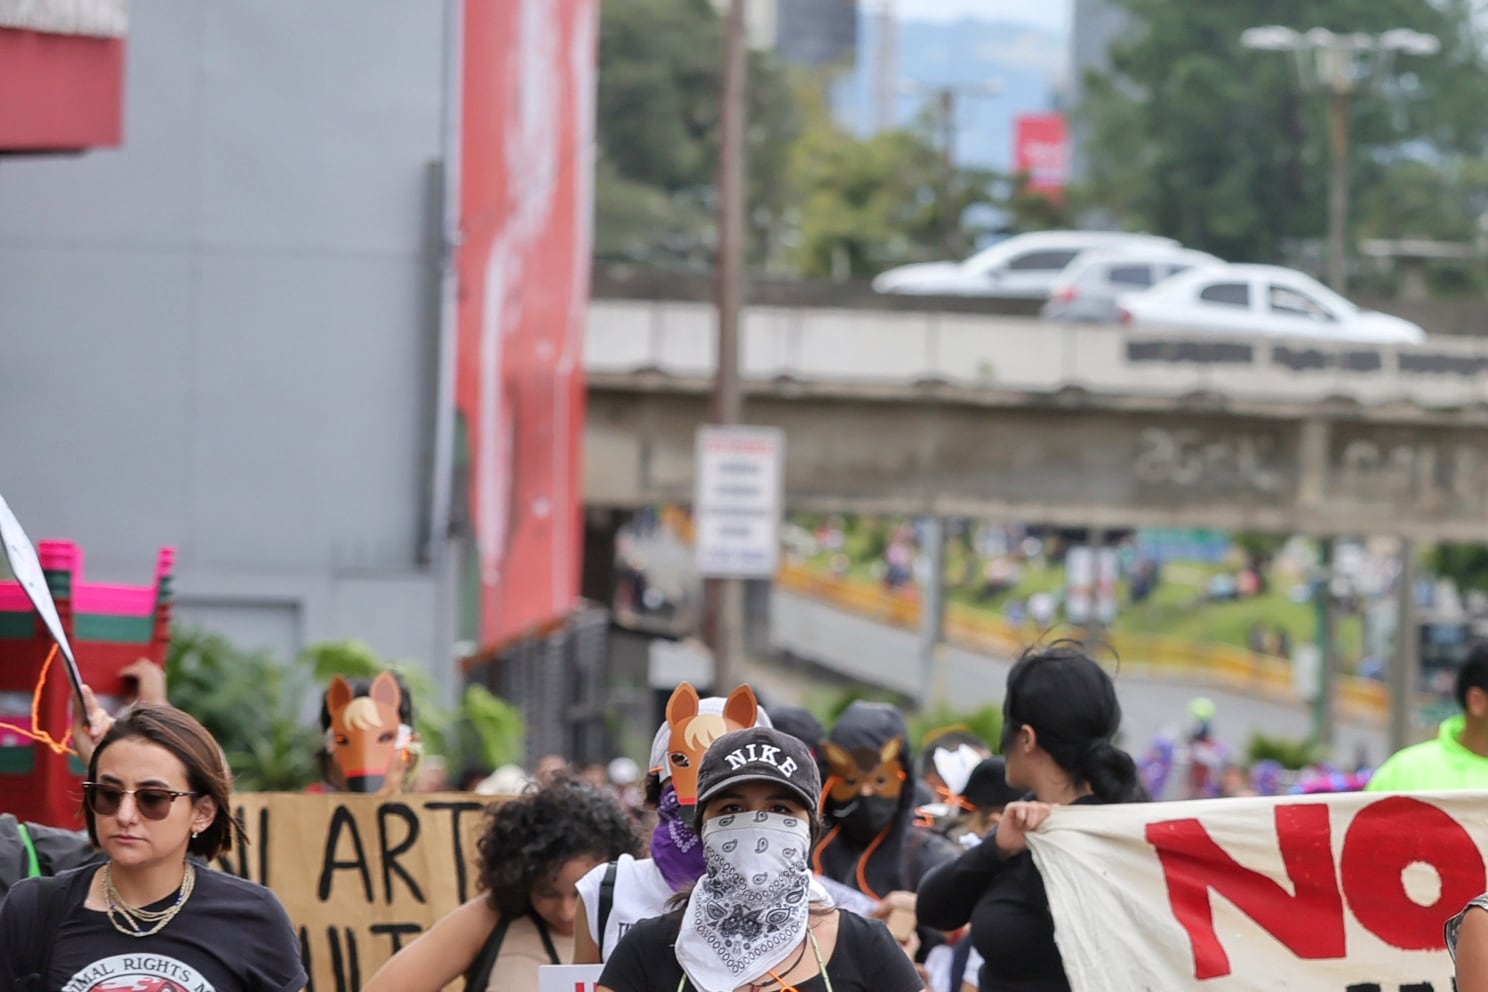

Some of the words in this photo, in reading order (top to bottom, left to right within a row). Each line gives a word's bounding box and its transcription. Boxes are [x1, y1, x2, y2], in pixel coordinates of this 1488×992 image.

[725, 744, 798, 778] NIKE
[317, 802, 484, 906] ART
[1146, 796, 1487, 979] NO
[123, 957, 193, 983] RIGHTS
